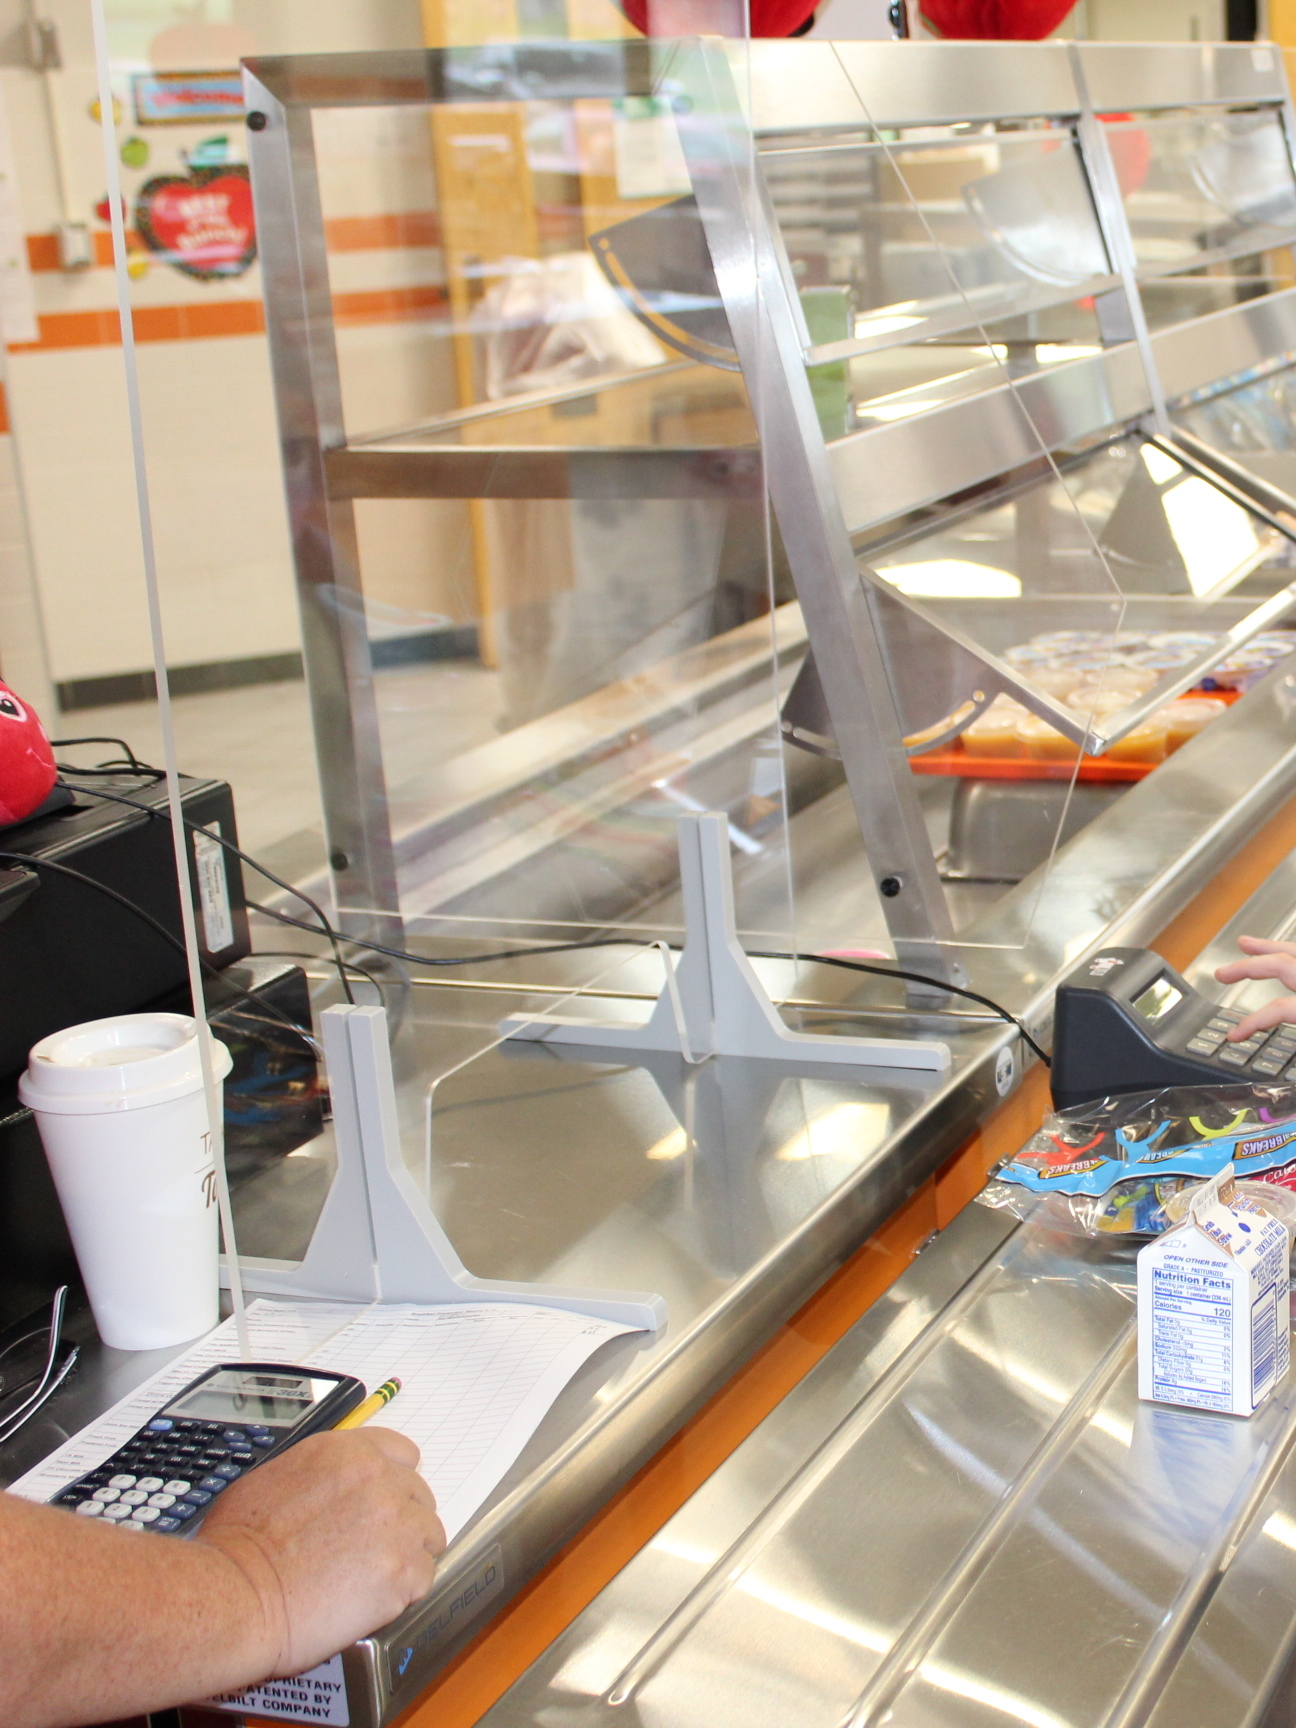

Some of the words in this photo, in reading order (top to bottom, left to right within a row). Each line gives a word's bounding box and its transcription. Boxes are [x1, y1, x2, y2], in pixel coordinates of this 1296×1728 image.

[1254, 1232, 1278, 1257] CHOCOLATE
[1274, 1224, 1287, 1239] MILK
[1163, 1254, 1185, 1263] OPEN
[1185, 1257, 1210, 1266] OTHER
[1211, 1260, 1228, 1269] SIDE
[1163, 1263, 1180, 1271] GRADE
[1191, 1267, 1224, 1277] PASTEURIZED
[1154, 1270, 1200, 1285] Nutrition
[1202, 1277, 1231, 1289] Facts
[1158, 1280, 1176, 1289] serving
[1186, 1284, 1208, 1292] container
[1154, 1285, 1173, 1294] Serving
[1190, 1291, 1211, 1299] container
[1154, 1299, 1182, 1310] Calories
[1214, 1307, 1231, 1318] 120
[314, 1694, 332, 1705] BY
[262, 1698, 331, 1718] COMPANY
